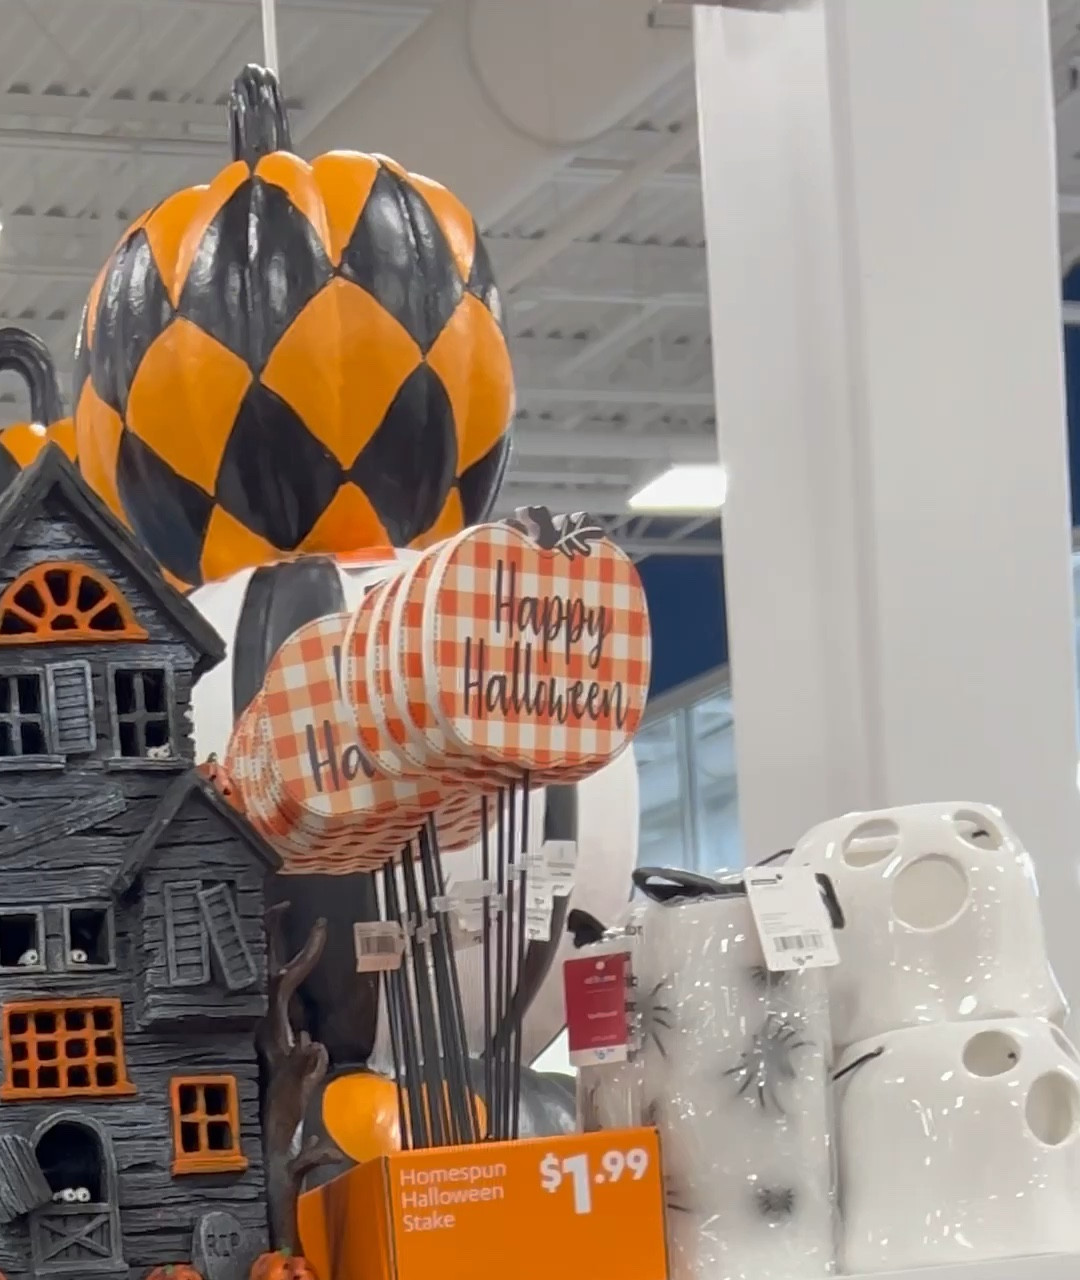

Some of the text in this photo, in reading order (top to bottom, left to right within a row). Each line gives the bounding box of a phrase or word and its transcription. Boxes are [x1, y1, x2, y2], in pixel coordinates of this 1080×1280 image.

[494, 558, 610, 670] Happy
[463, 635, 632, 731] Halloween
[305, 718, 376, 793] Ha
[399, 1147, 650, 1215] Homespun $1.99
[400, 1184, 505, 1209] Halloween
[207, 1231, 240, 1258] RIP
[402, 1210, 457, 1232] Stake
